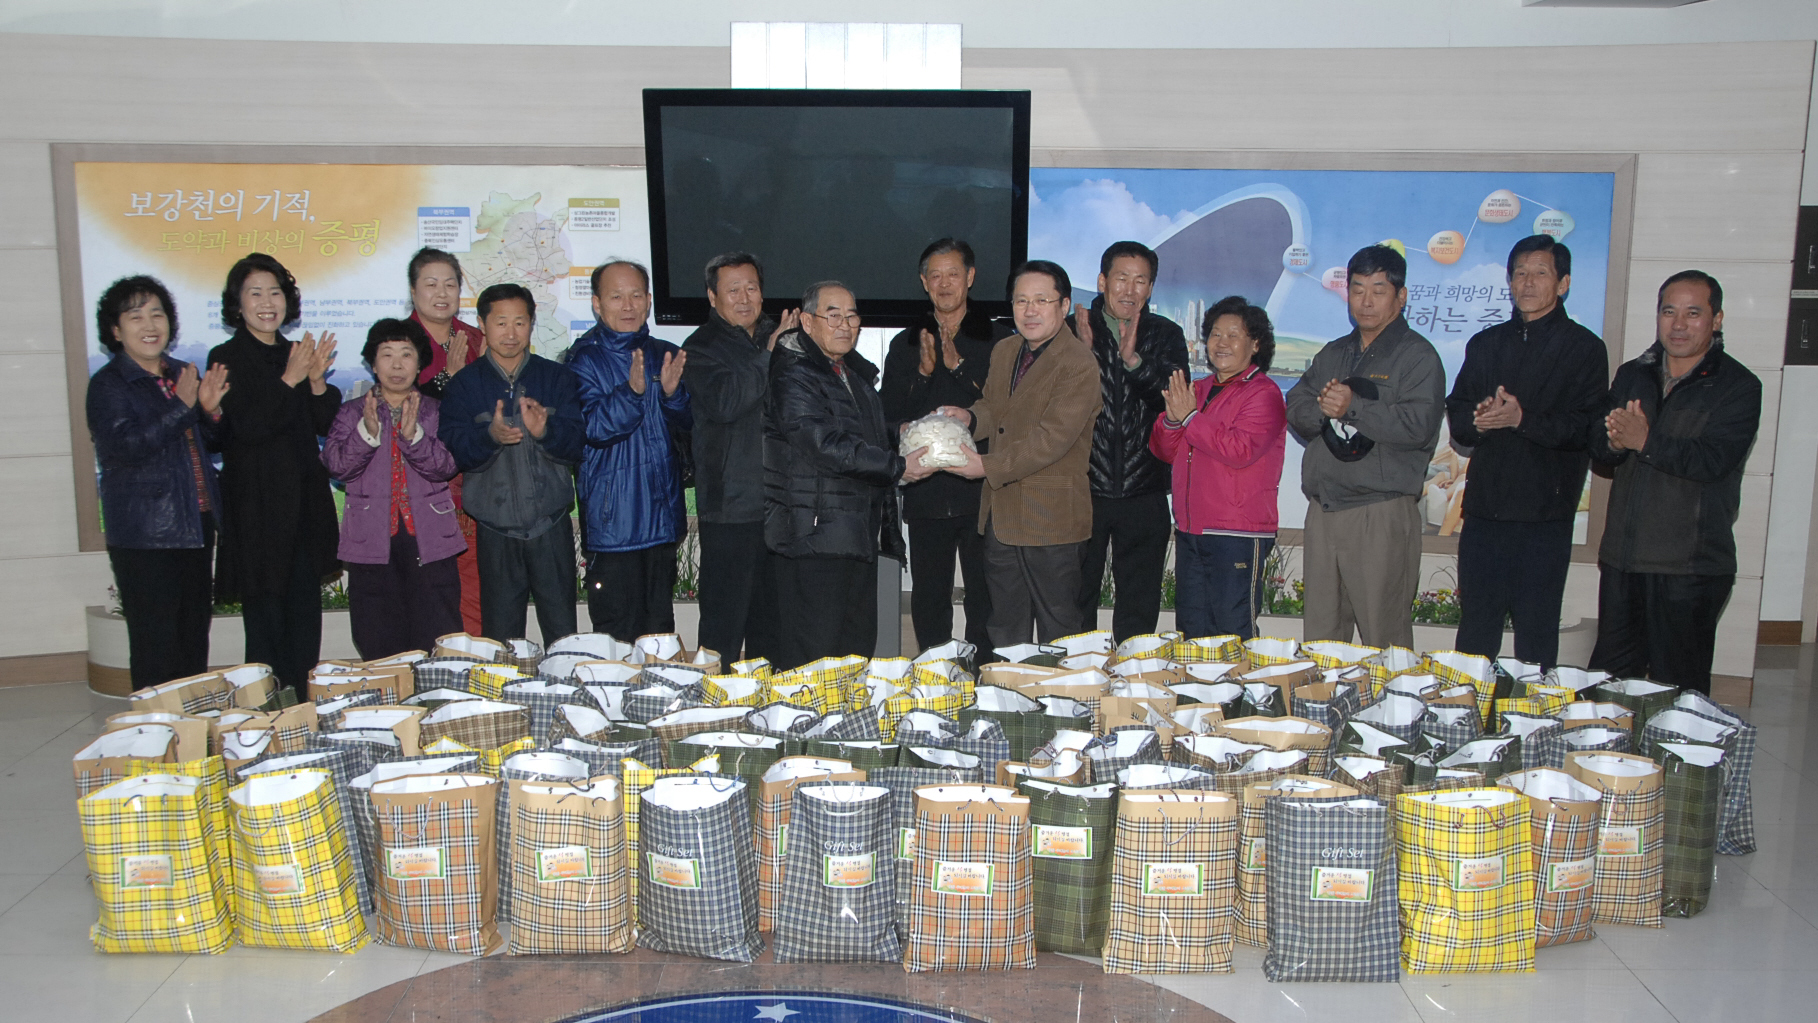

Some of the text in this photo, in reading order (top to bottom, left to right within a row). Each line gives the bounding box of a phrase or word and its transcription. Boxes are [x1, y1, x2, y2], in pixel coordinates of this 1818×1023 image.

[123, 189, 315, 224] 보강천의 기적,
[157, 219, 381, 257] 도약과 비상의 증평
[1409, 284, 1442, 302] 꿈과
[1444, 284, 1493, 303] 희망의
[657, 843, 693, 857] Gift Set
[824, 841, 864, 854] Gift Set
[1321, 846, 1364, 861] Gift Set
